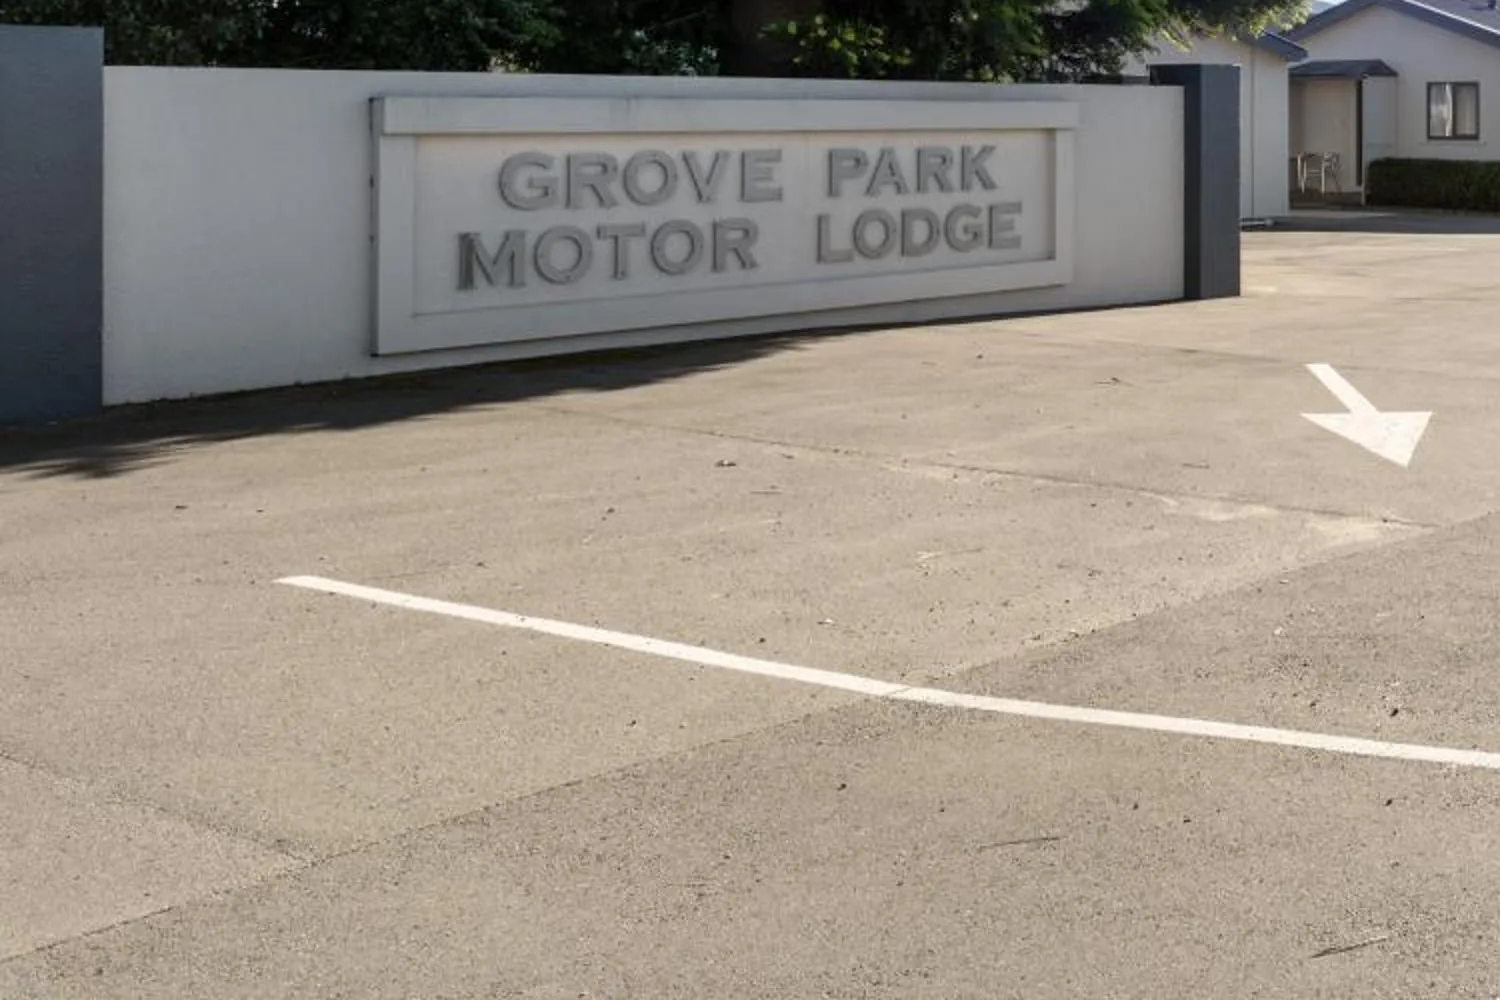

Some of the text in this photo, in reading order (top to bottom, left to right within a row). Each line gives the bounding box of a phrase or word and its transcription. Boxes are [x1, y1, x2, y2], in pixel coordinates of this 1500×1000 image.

[499, 144, 998, 211] GROVE PARK
[456, 201, 1022, 292] MOTOR LODGE
